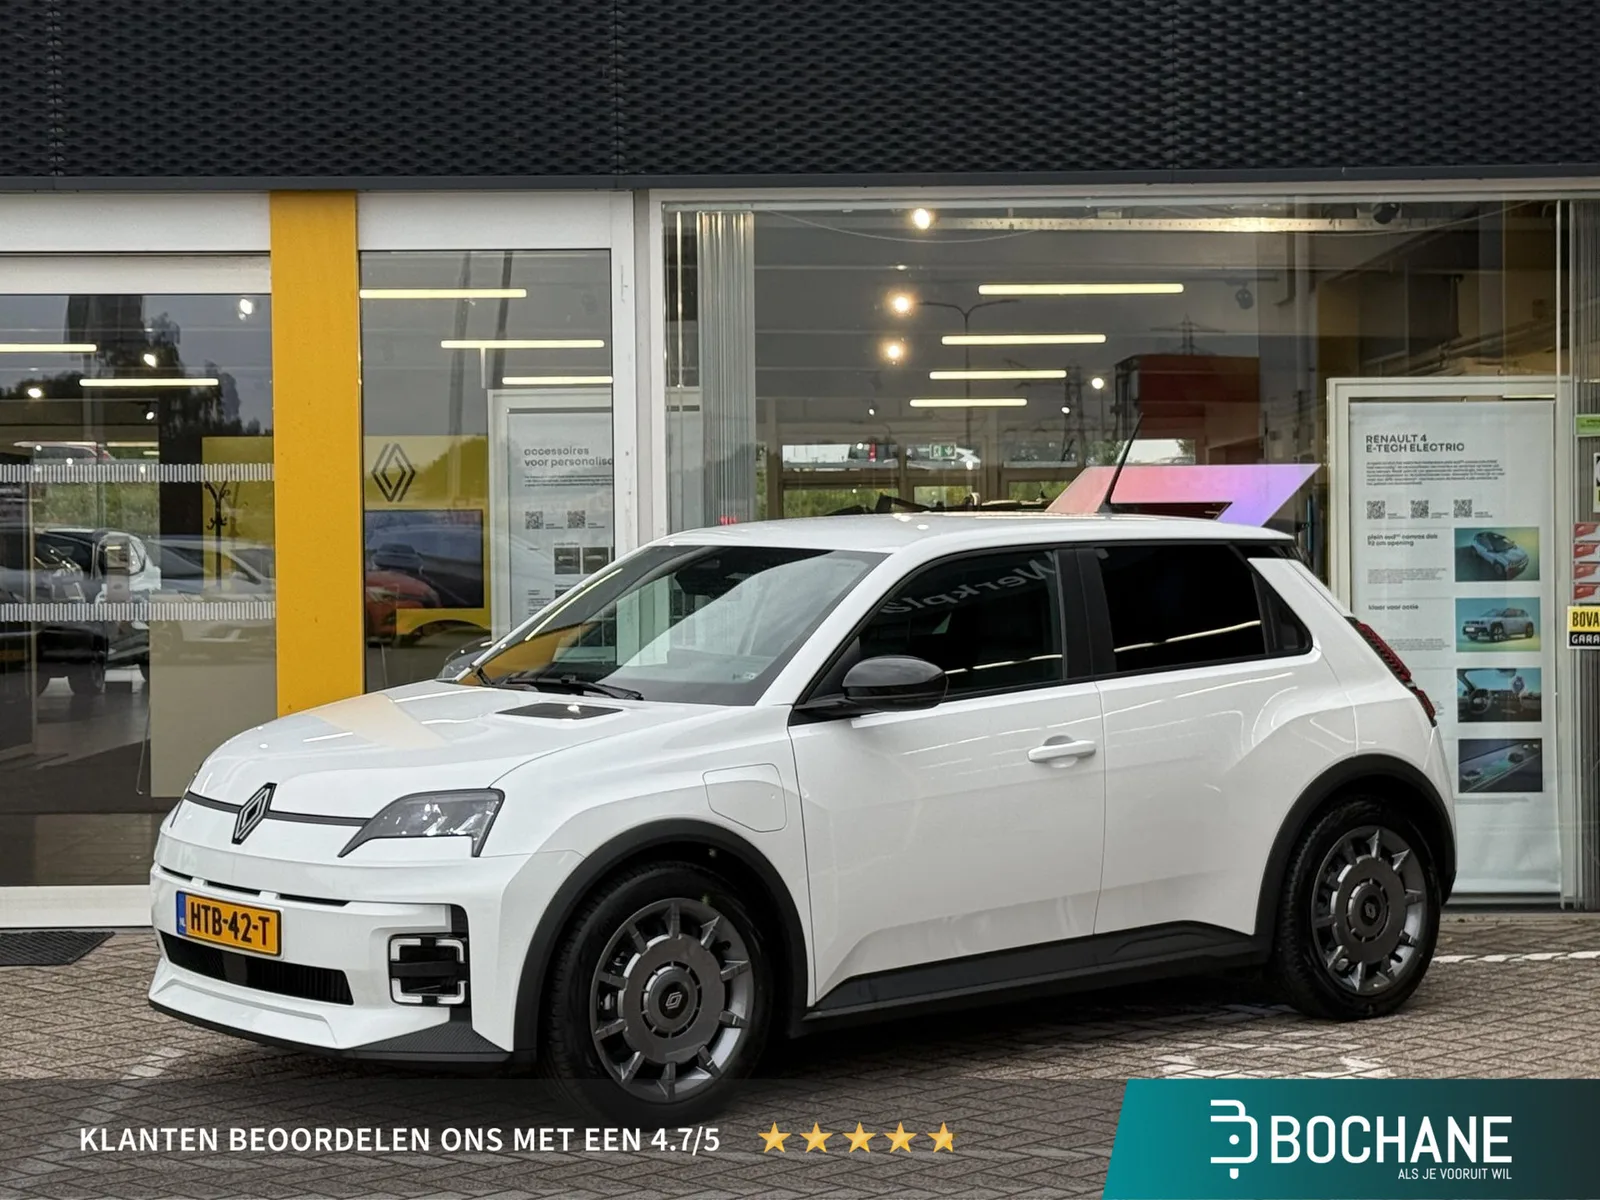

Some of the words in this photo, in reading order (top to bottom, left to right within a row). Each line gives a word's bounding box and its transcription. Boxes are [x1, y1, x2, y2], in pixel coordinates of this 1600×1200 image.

[1366, 434, 1418, 443] RENAULT
[1420, 434, 1427, 442] 4
[524, 446, 589, 456] accessoires
[1366, 443, 1407, 453] E-TECH
[1410, 443, 1465, 452] ELECTRIC
[524, 459, 549, 467] voor
[1572, 611, 1600, 627] BOVA
[1571, 634, 1600, 644] GARA
[190, 901, 270, 946] HTB-42-T
